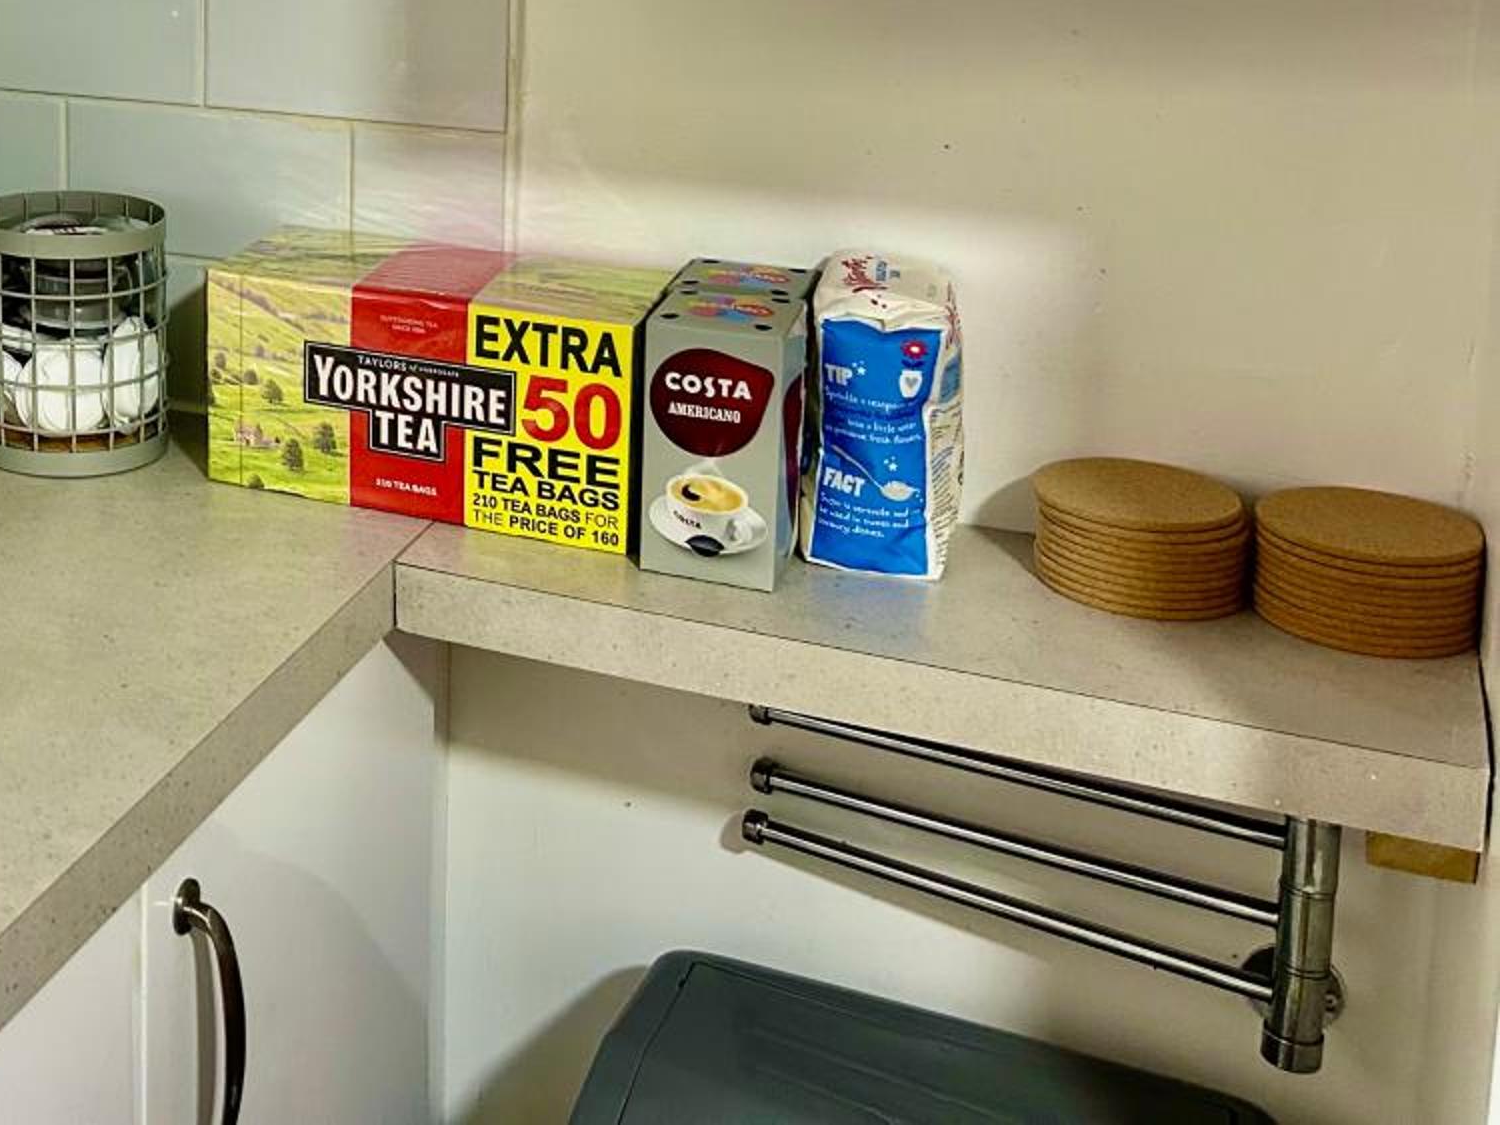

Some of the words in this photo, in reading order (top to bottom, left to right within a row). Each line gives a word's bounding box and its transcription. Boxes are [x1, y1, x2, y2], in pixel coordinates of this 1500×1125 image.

[357, 354, 407, 372] TAYLORS
[475, 314, 623, 378] EXTRA
[313, 354, 507, 425] YORKSHIRE
[664, 371, 753, 401] COSTA
[824, 363, 853, 386] TIP
[521, 375, 623, 450] 50
[667, 401, 741, 424] AMERICANO
[375, 410, 439, 454] TEA
[473, 435, 620, 489] FREE
[393, 480, 411, 492] TEA
[411, 484, 437, 496] BAGS
[472, 469, 530, 496] TEA
[537, 480, 619, 511] BAGS
[822, 466, 866, 497] FACT
[473, 493, 497, 508] 210
[501, 498, 532, 515] TEA
[536, 503, 581, 523] BAGS
[585, 512, 619, 530] FOR
[473, 508, 504, 526] THE
[509, 514, 558, 535] PRICE
[563, 524, 585, 540] OF
[592, 529, 619, 546] 160
